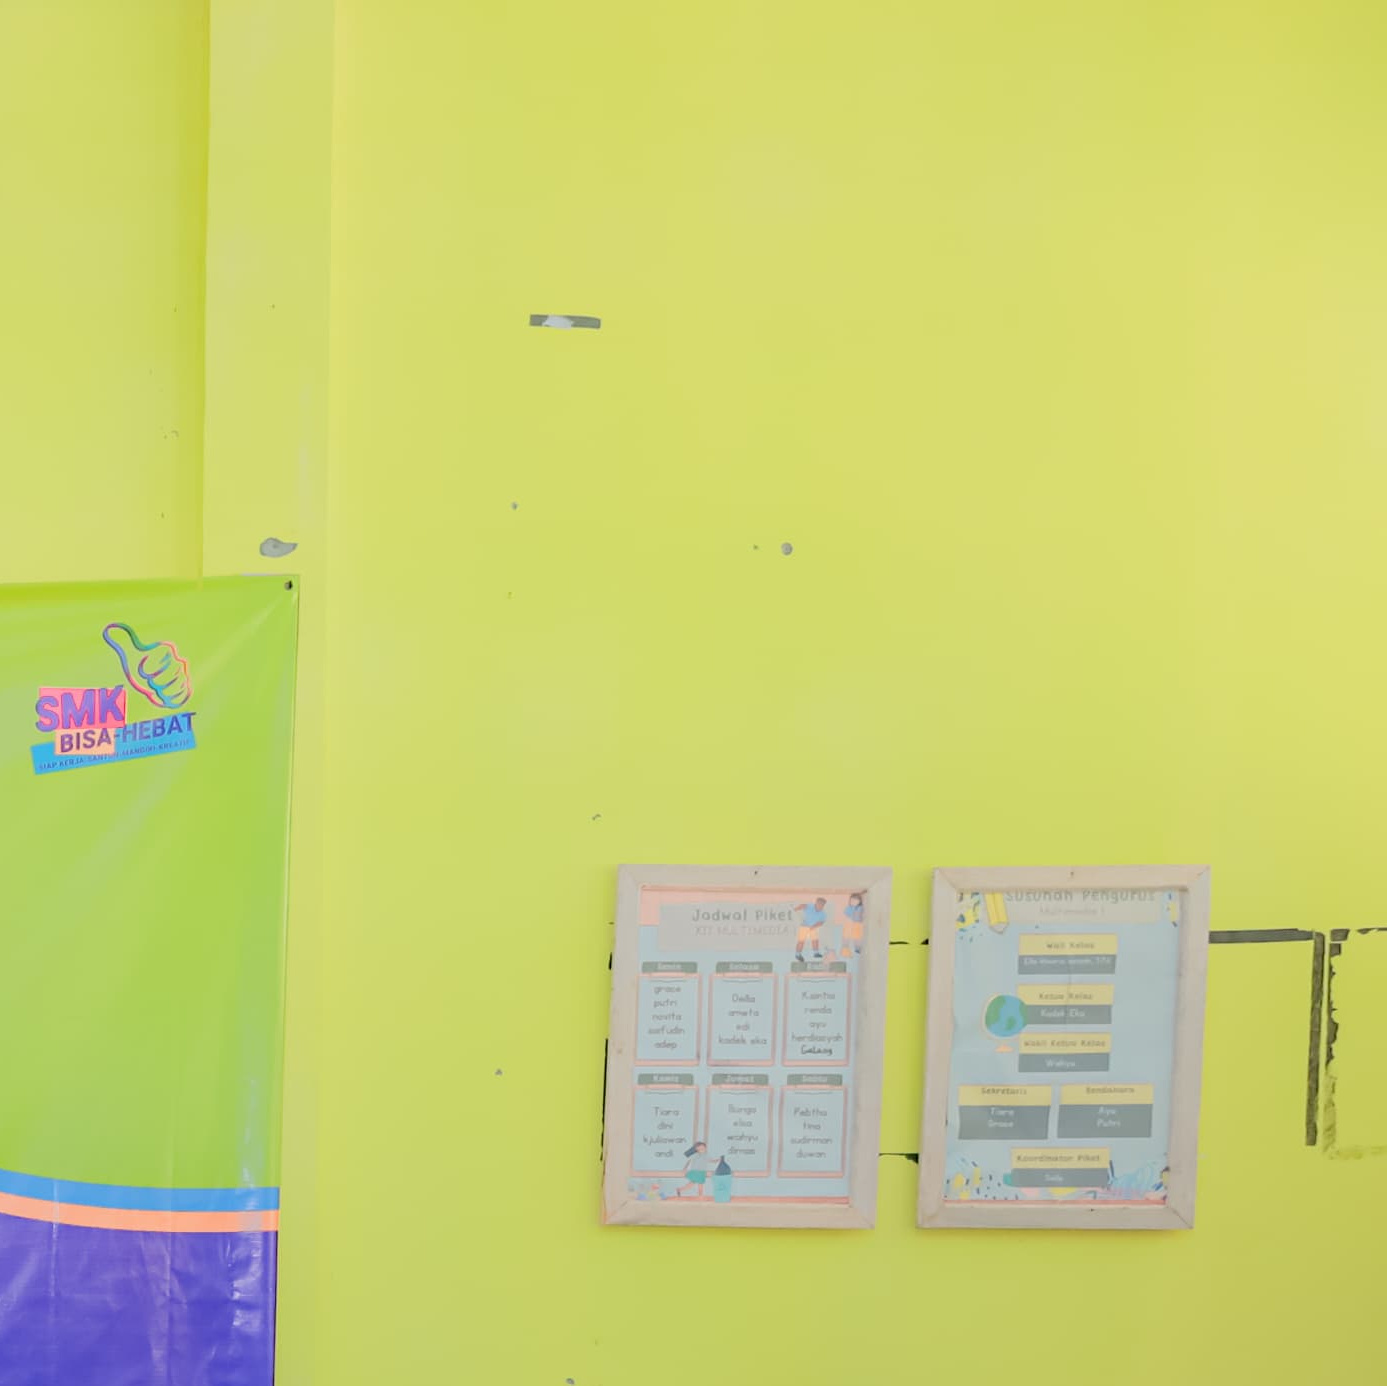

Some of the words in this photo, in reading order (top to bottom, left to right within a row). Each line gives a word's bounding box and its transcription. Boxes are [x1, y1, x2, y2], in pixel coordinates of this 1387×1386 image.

[35, 684, 125, 733] SMK
[692, 908, 748, 921] Jadwal
[755, 908, 793, 921] Piket
